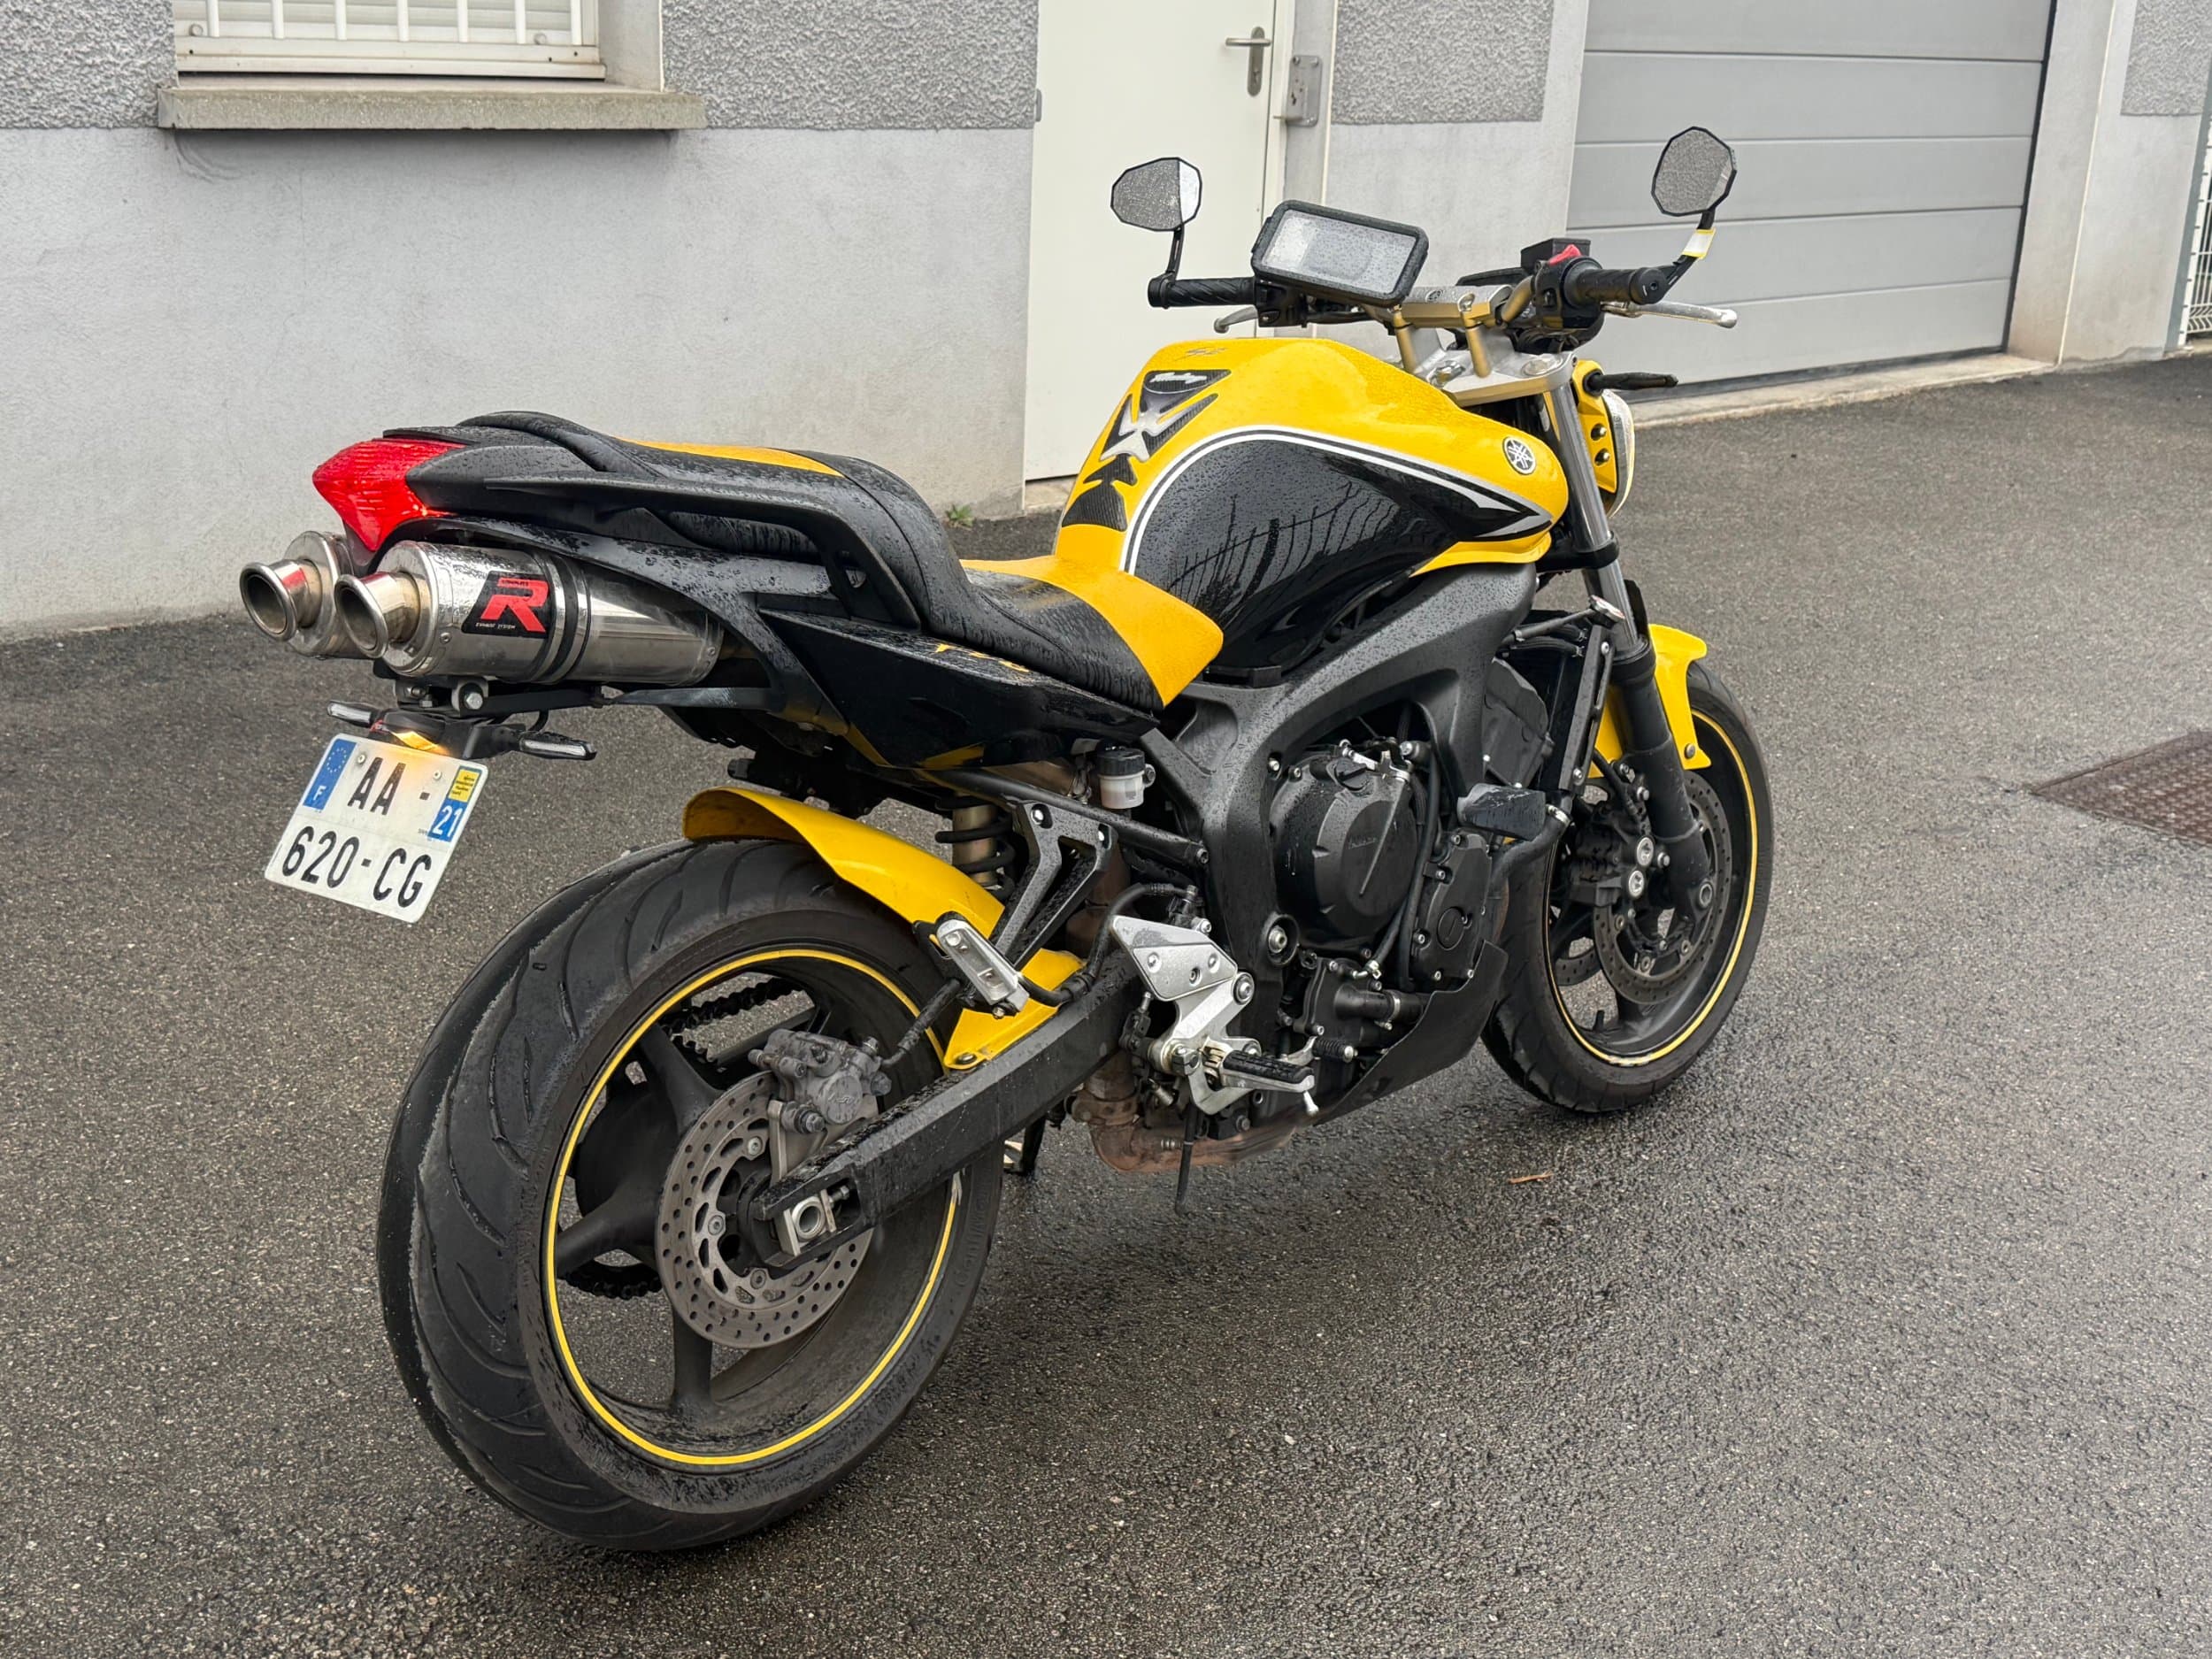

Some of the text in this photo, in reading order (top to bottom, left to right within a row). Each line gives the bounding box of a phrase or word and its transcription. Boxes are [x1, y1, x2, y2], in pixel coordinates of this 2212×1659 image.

[480, 577, 549, 634] R
[312, 785, 326, 801] F
[433, 805, 461, 836] 21
[282, 826, 432, 908] 620-CG
